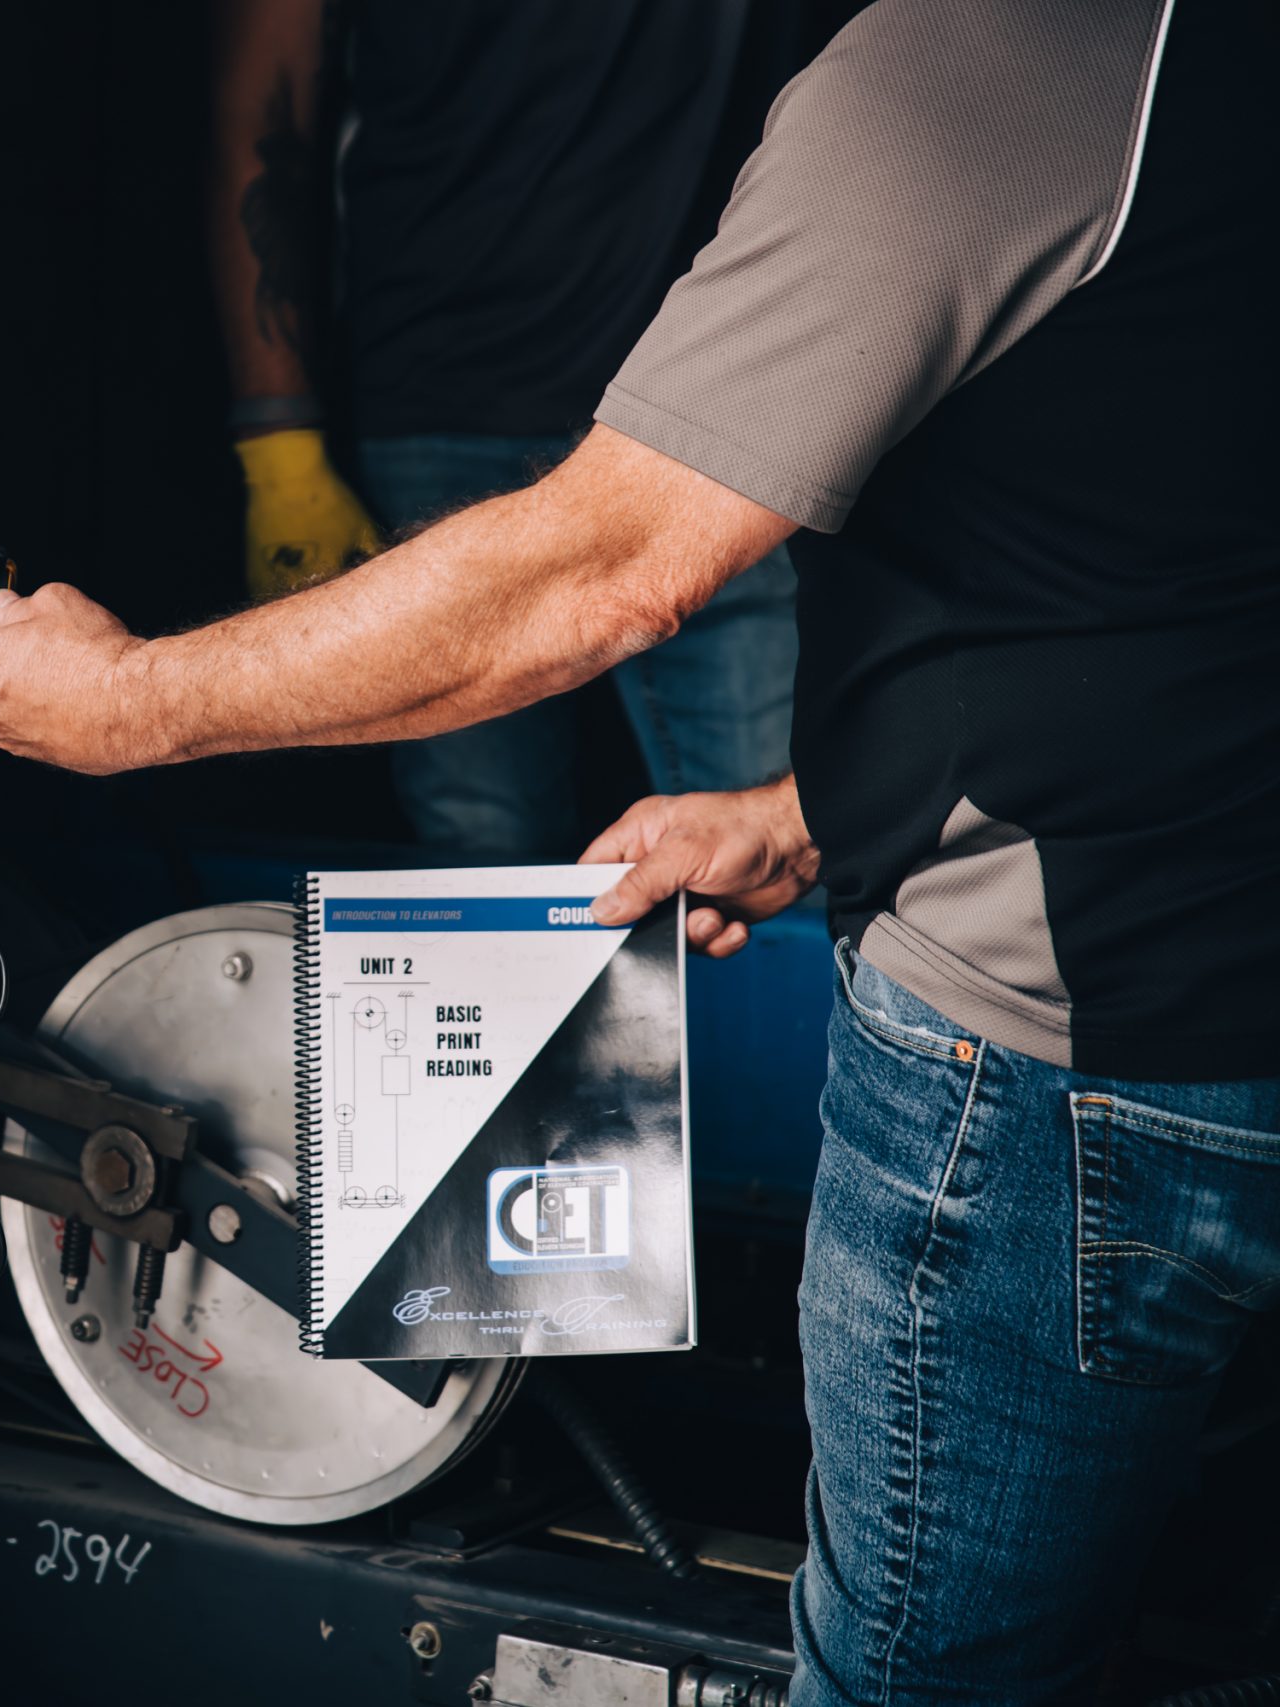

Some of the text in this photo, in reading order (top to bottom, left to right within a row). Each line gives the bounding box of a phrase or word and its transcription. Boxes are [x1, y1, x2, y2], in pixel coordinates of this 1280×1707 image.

[332, 909, 463, 921] INTRODUCTION TO ELEVATORS
[547, 906, 594, 925] COUR
[360, 957, 413, 975] UNIT 2
[435, 1005, 482, 1023] BASIC
[436, 1032, 481, 1050] PRINT
[426, 1060, 493, 1077] READING
[479, 1325, 524, 1335] THRU
[119, 1328, 210, 1418] CLOSE
